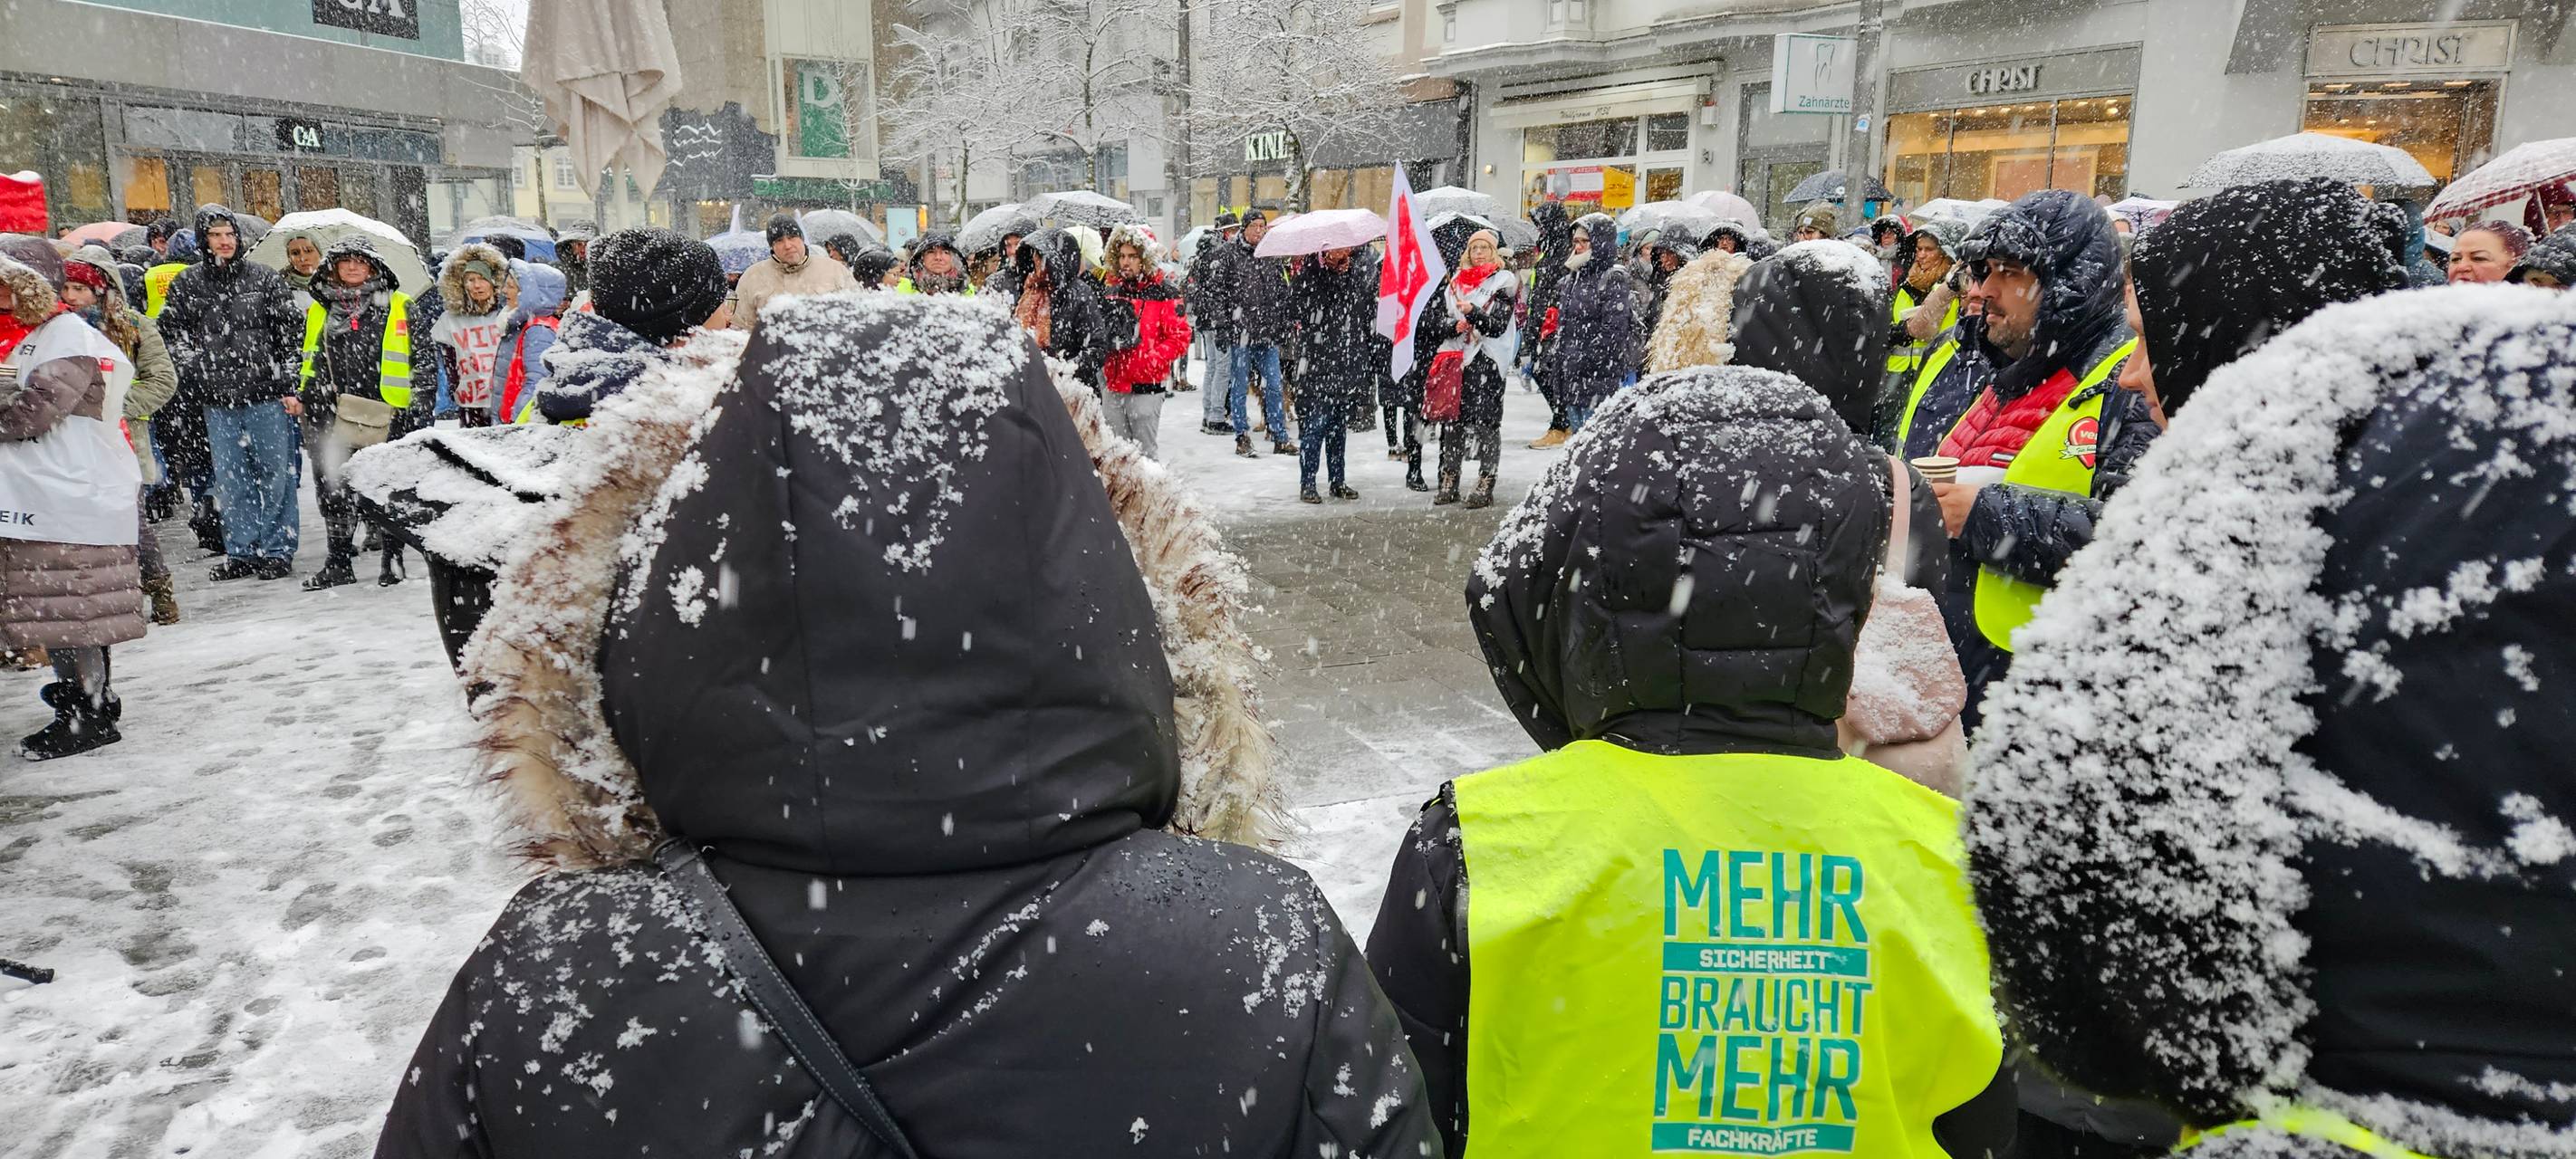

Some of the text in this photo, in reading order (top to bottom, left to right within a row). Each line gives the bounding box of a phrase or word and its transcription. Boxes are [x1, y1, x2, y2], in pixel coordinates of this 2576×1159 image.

[2350, 34, 2472, 67] CHRIST
[1966, 66, 2042, 92] CHRIST
[1799, 95, 1850, 109] Zahnärzte
[0, 510, 35, 526] EIK
[1663, 848, 1869, 943] MEHR
[1699, 948, 1829, 971] SICHERHEIT
[1659, 975, 1873, 1035] BRAUCHT
[1654, 1033, 1858, 1122] MEHR
[1687, 1126, 1817, 1152] FACHKRÄFTE
